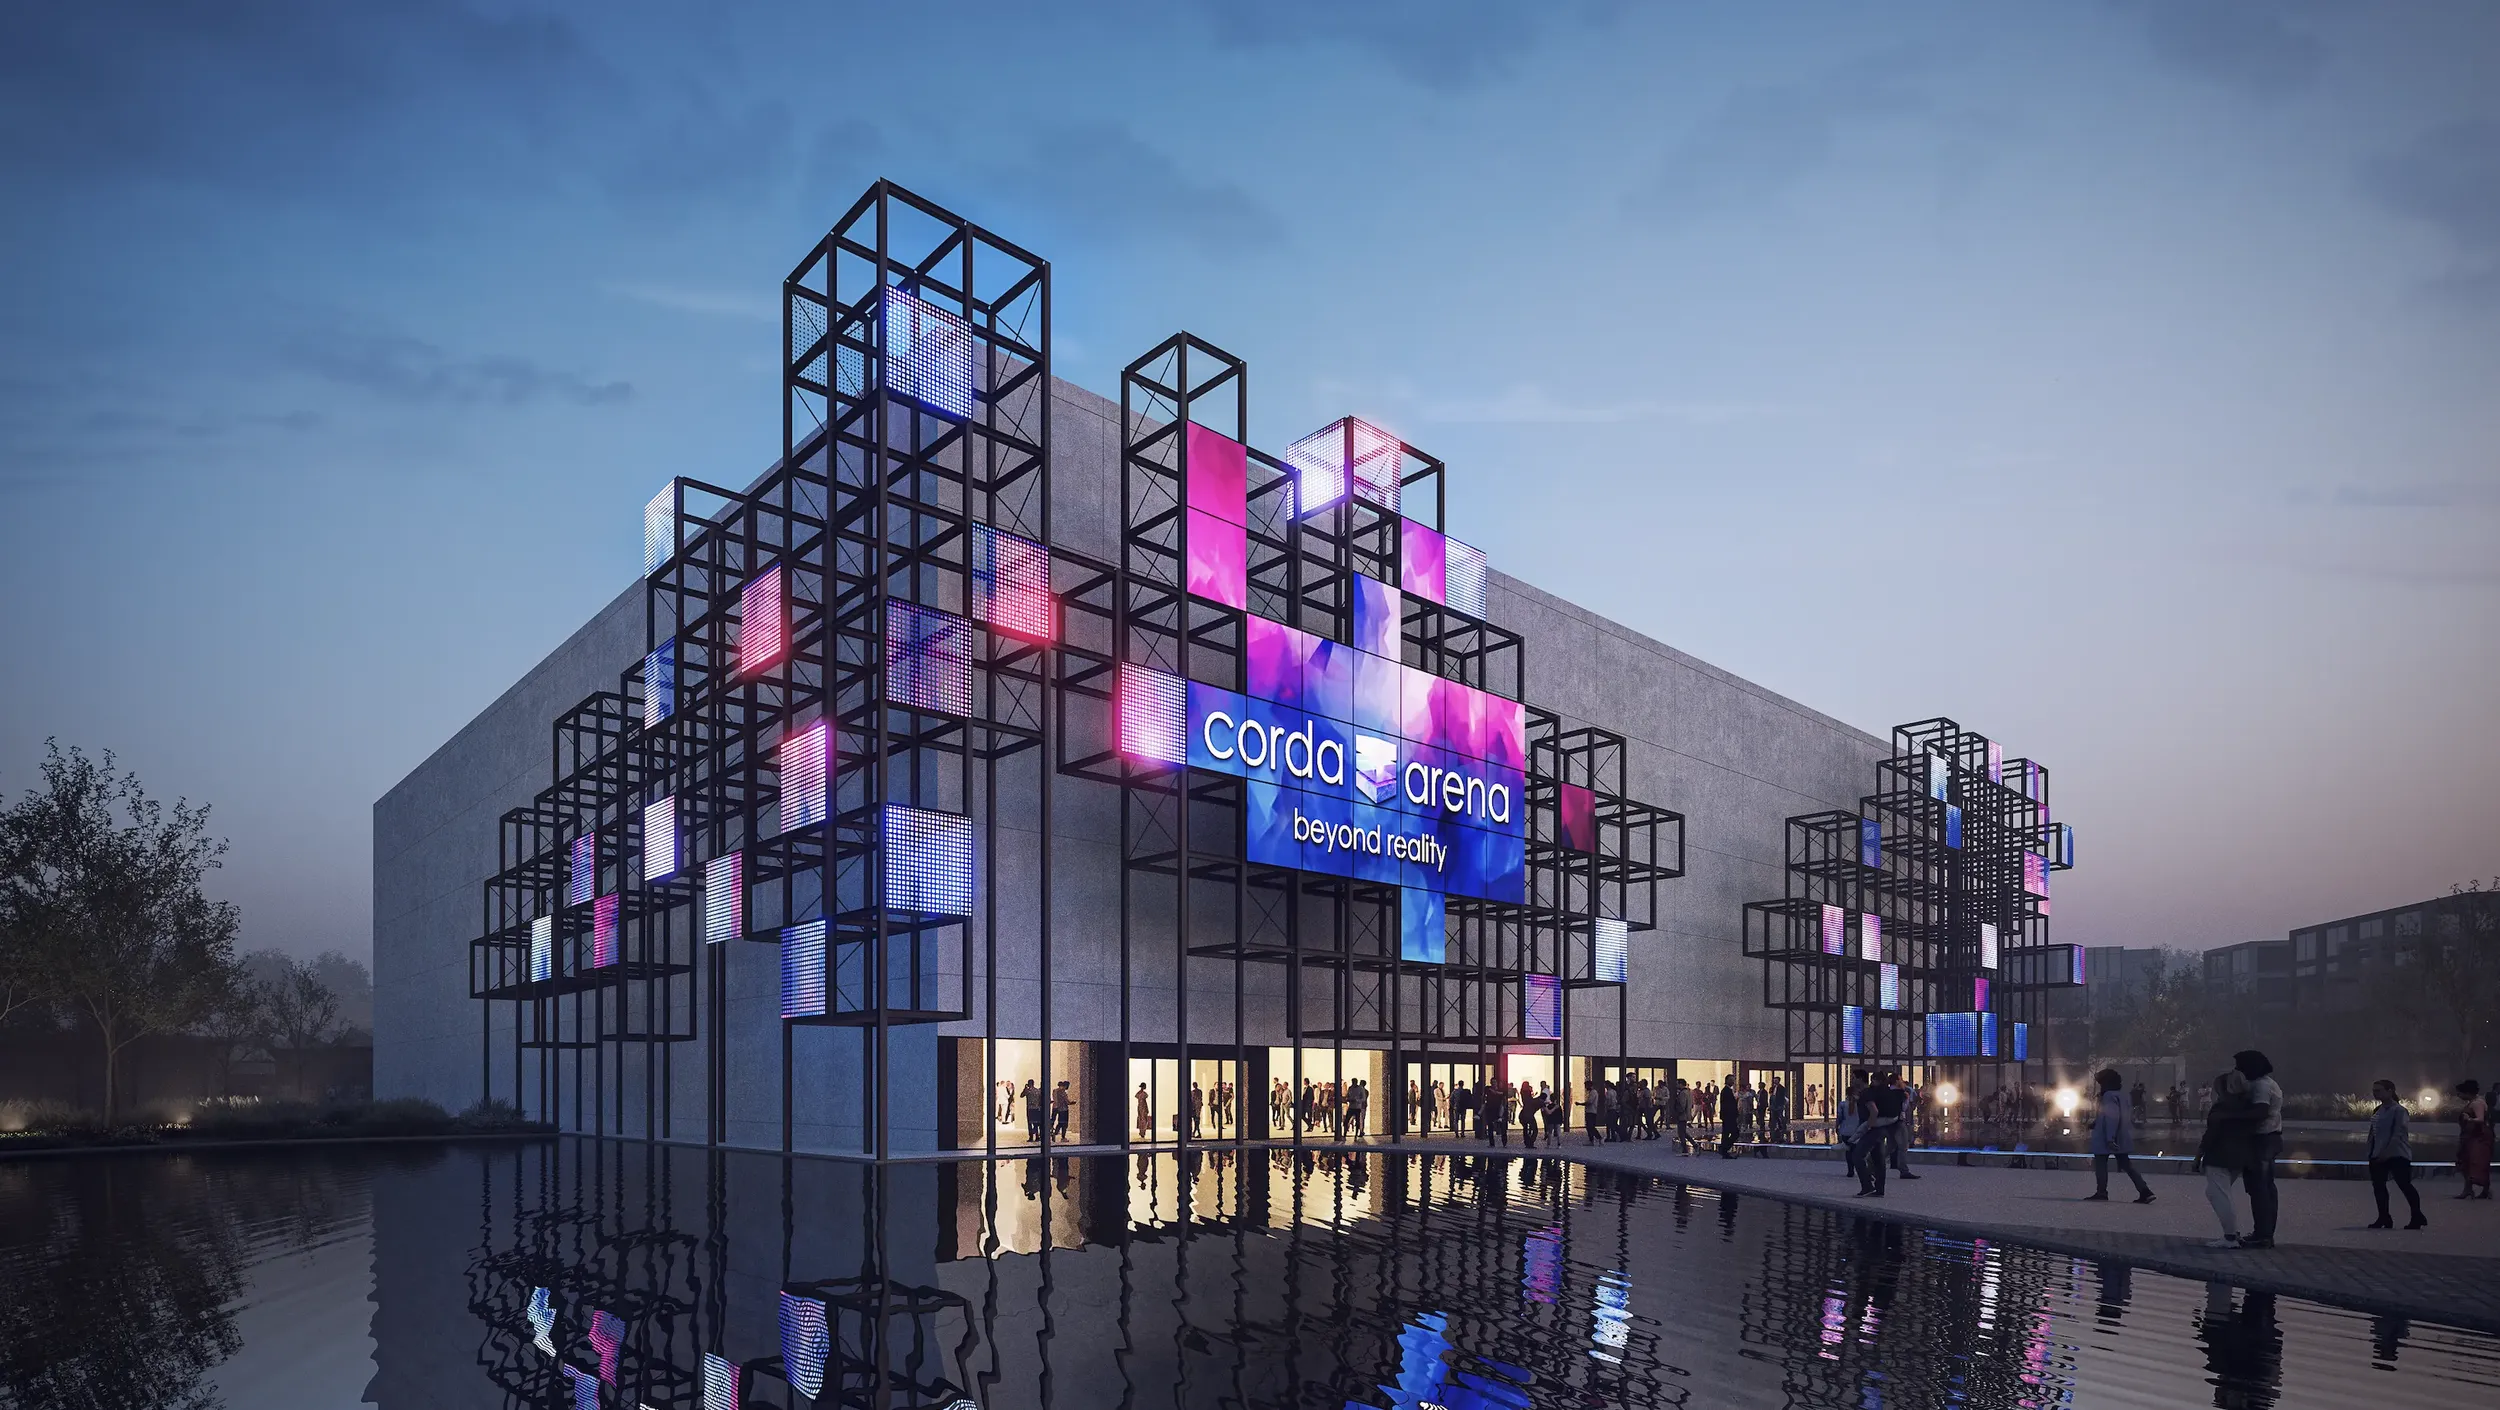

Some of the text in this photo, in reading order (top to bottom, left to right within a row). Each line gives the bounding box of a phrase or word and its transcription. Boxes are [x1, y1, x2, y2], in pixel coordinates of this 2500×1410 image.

[1203, 710, 1511, 824] corda arena
[1293, 808, 1448, 873] beyond reality
